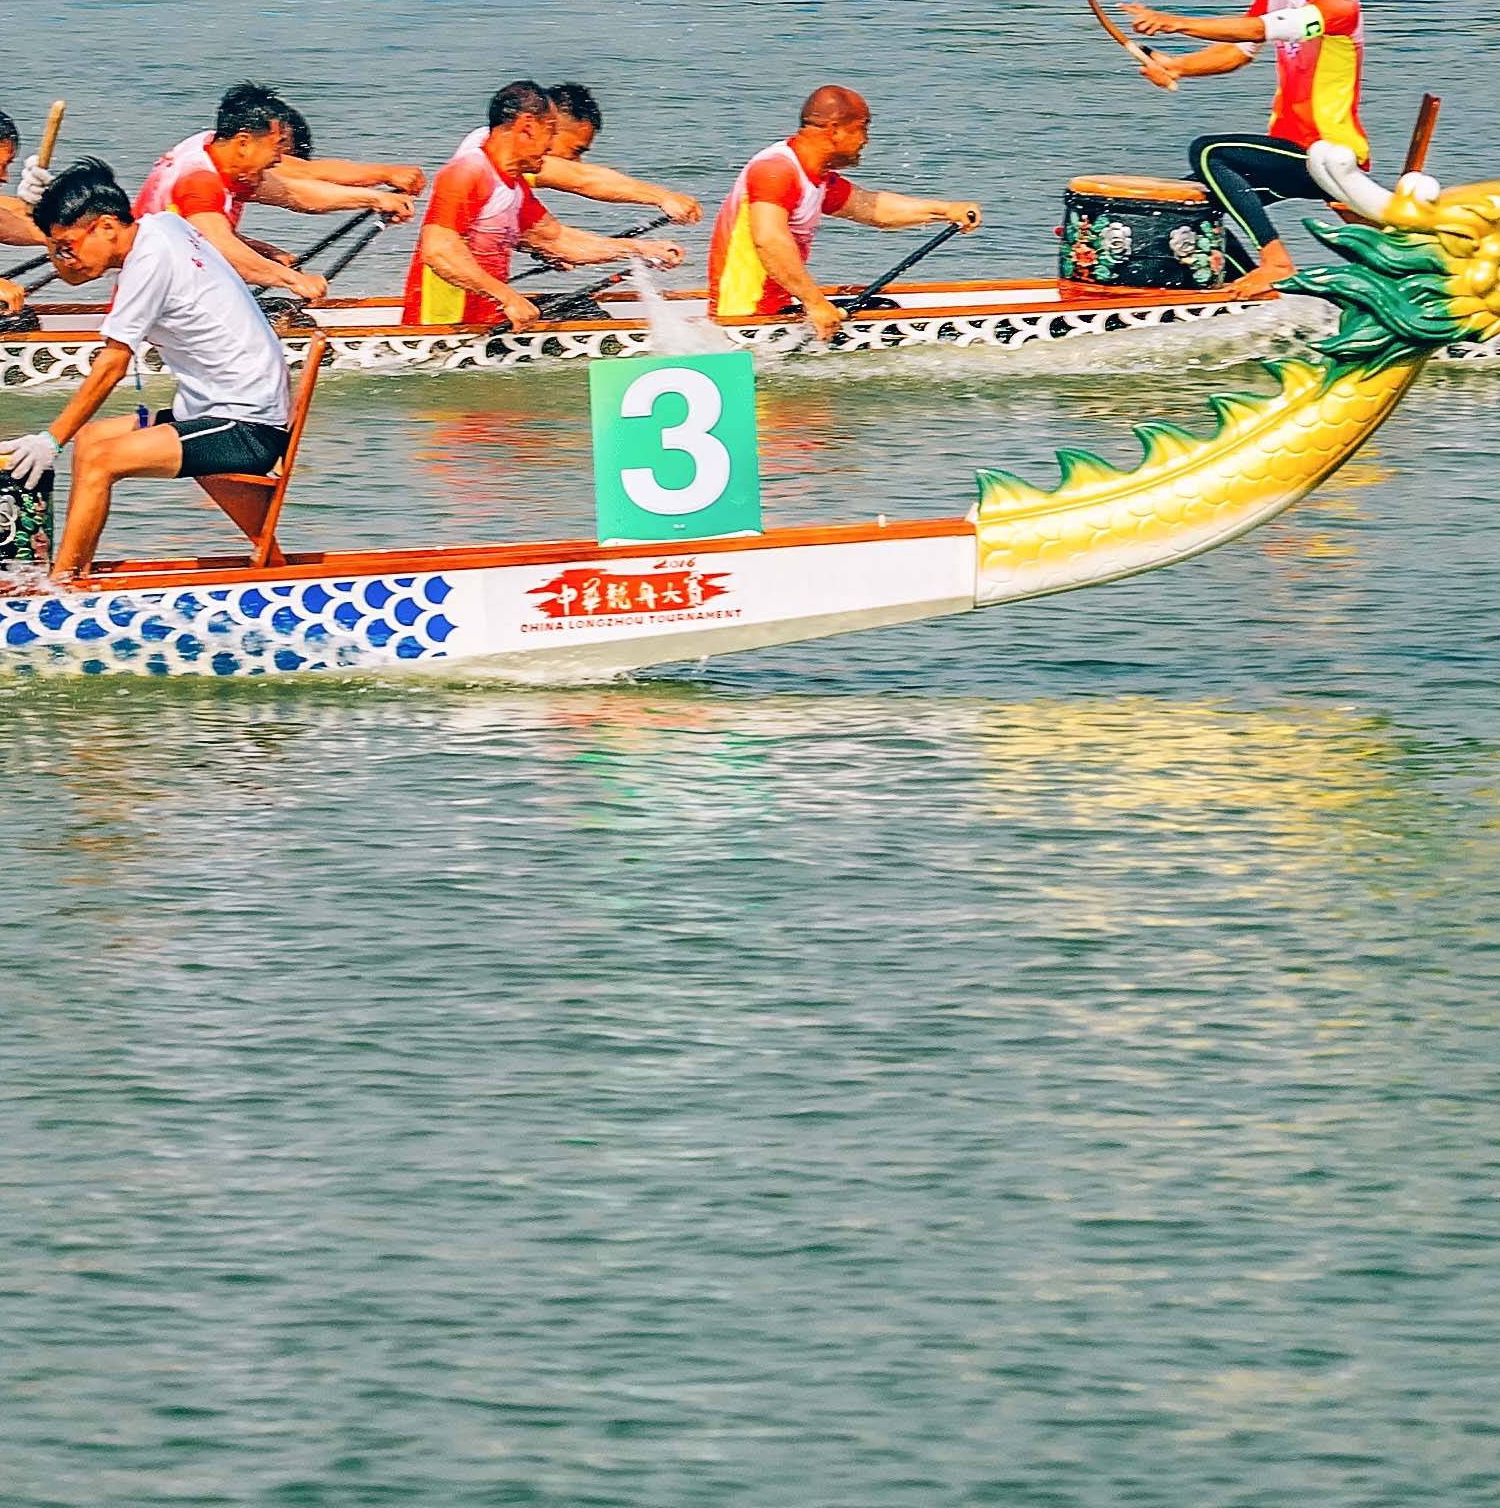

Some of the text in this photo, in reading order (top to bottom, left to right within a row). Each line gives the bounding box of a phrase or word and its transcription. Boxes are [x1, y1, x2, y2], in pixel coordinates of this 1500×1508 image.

[620, 367, 731, 515] 3
[652, 557, 697, 569] 2016
[520, 609, 742, 633] CHINA LONGZHOU TOURNAMENT
